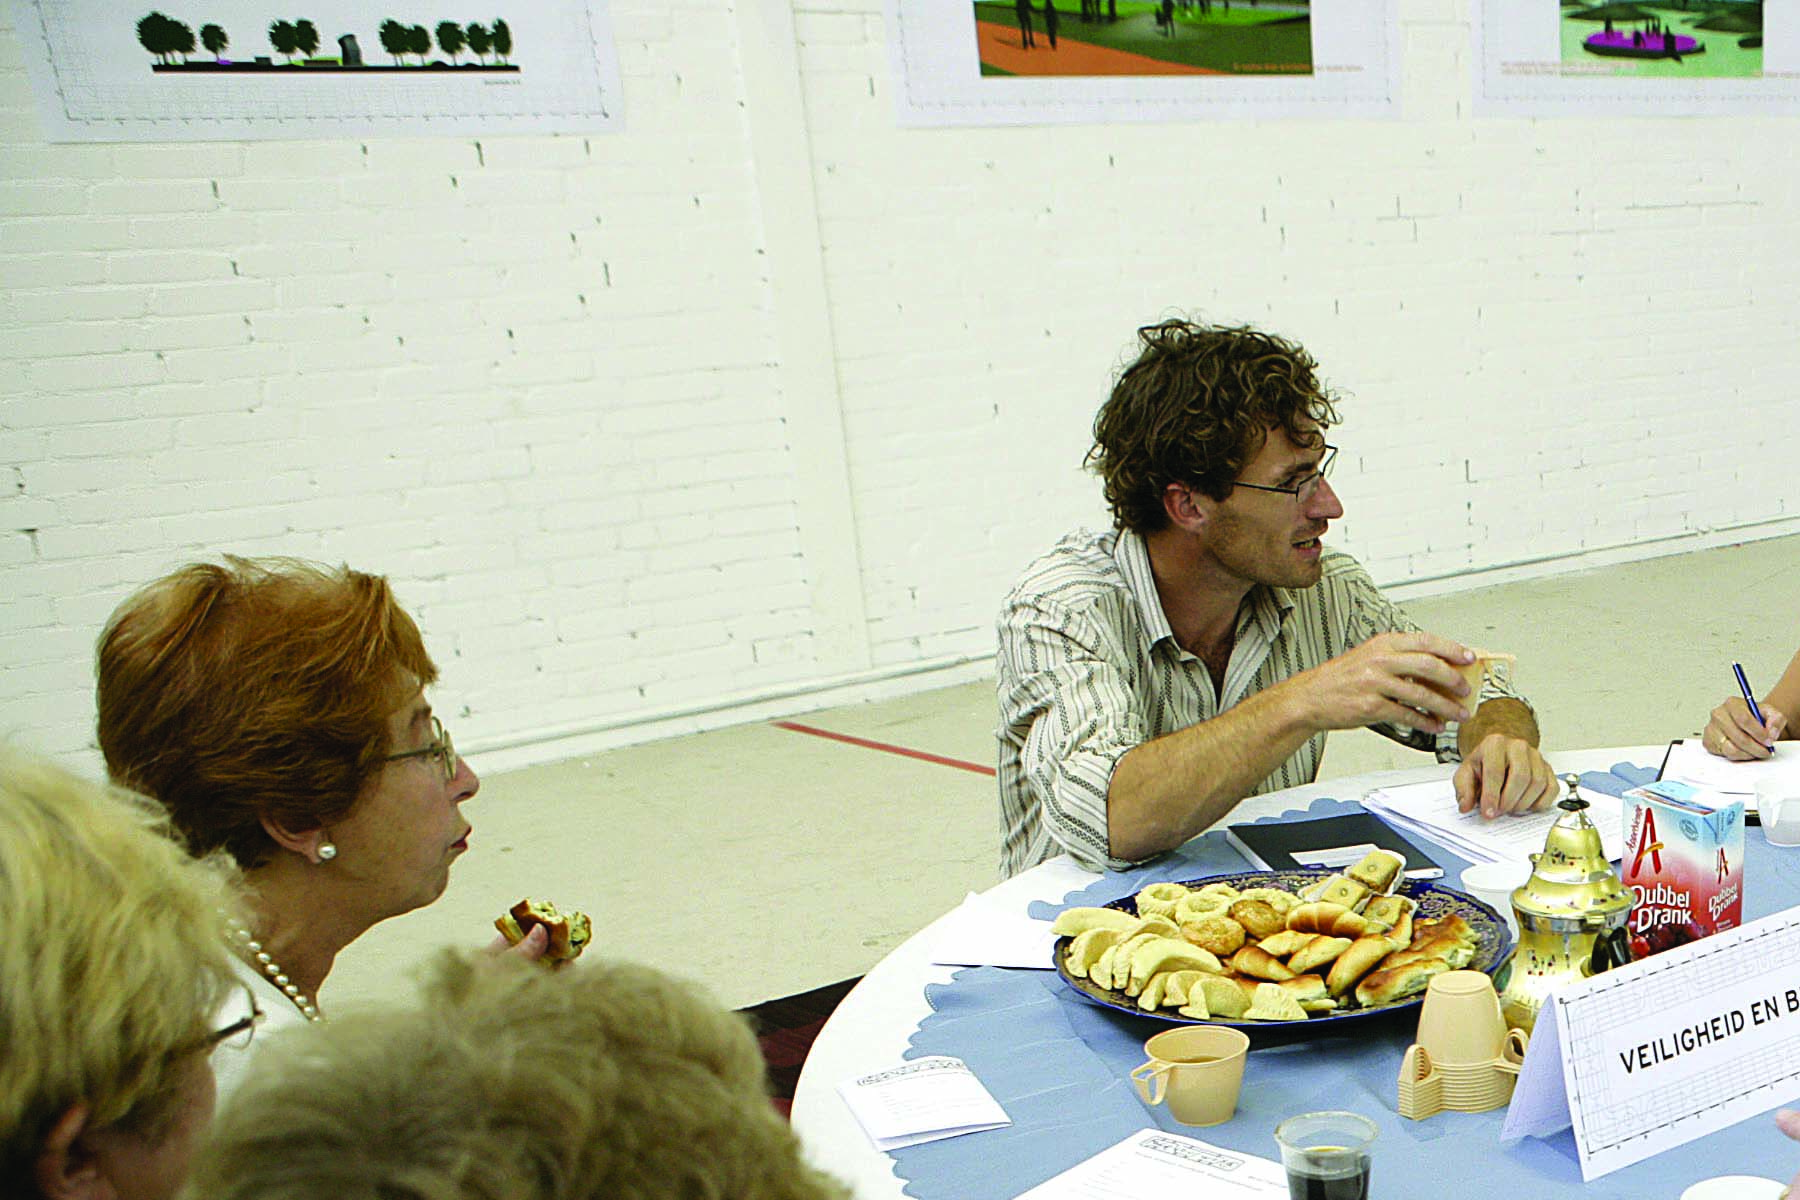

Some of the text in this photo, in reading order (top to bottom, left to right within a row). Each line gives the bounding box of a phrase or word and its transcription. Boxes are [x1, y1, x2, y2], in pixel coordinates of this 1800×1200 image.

[1630, 882, 1690, 909] Dubbel
[1636, 907, 1692, 933] Drank
[1620, 1010, 1745, 1074] VEILIGHEID
[1751, 996, 1780, 1026] EN
